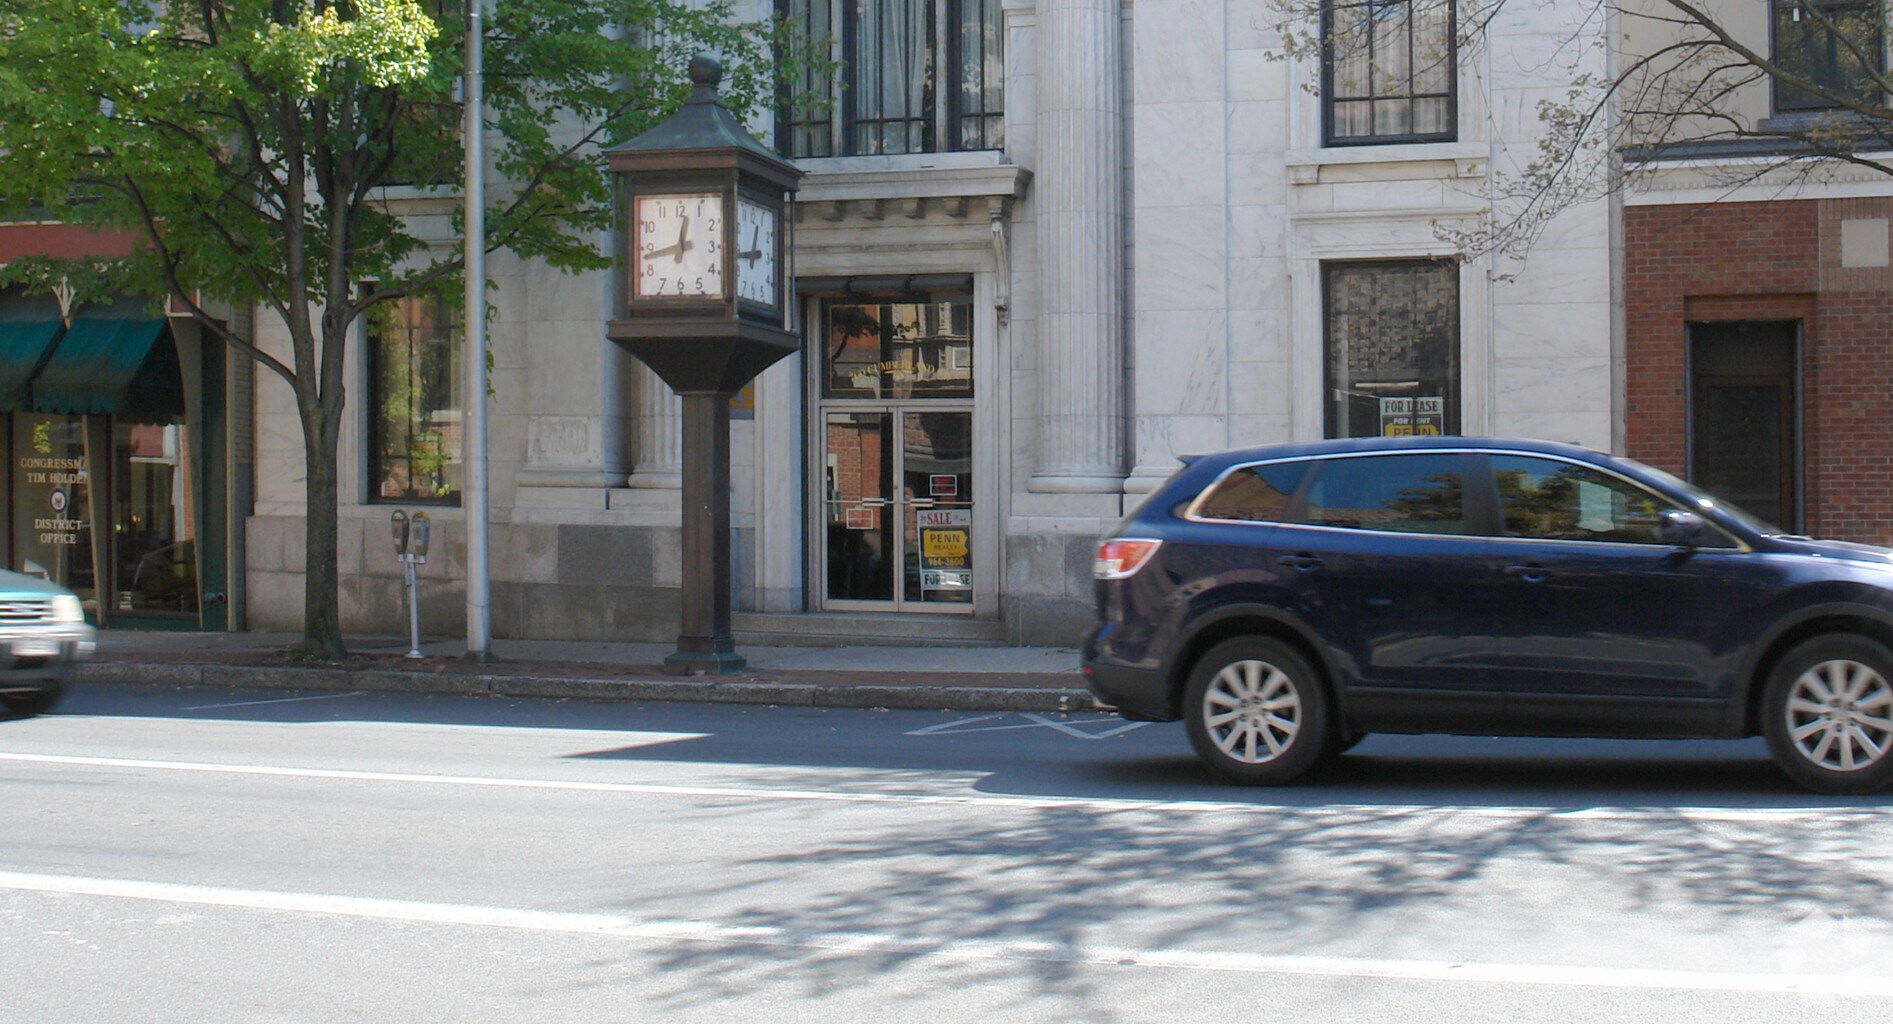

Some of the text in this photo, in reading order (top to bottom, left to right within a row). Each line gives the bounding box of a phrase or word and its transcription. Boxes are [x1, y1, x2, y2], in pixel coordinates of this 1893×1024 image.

[658, 205, 701, 219] 11 12 1
[644, 221, 656, 234] 10
[708, 218, 715, 232] 2
[708, 241, 716, 254] 3
[646, 264, 654, 277] 8
[707, 263, 716, 275] 4
[659, 277, 703, 291] 7 6 5
[1384, 400, 1404, 413] FOR
[1393, 417, 1431, 425] FOR ENT
[1393, 427, 1432, 436] PEN
[26, 472, 46, 483] TIM
[34, 518, 83, 530] DISTRICT
[927, 512, 952, 525] SALE
[40, 532, 77, 544] OFFICE
[930, 533, 960, 543] PENN
